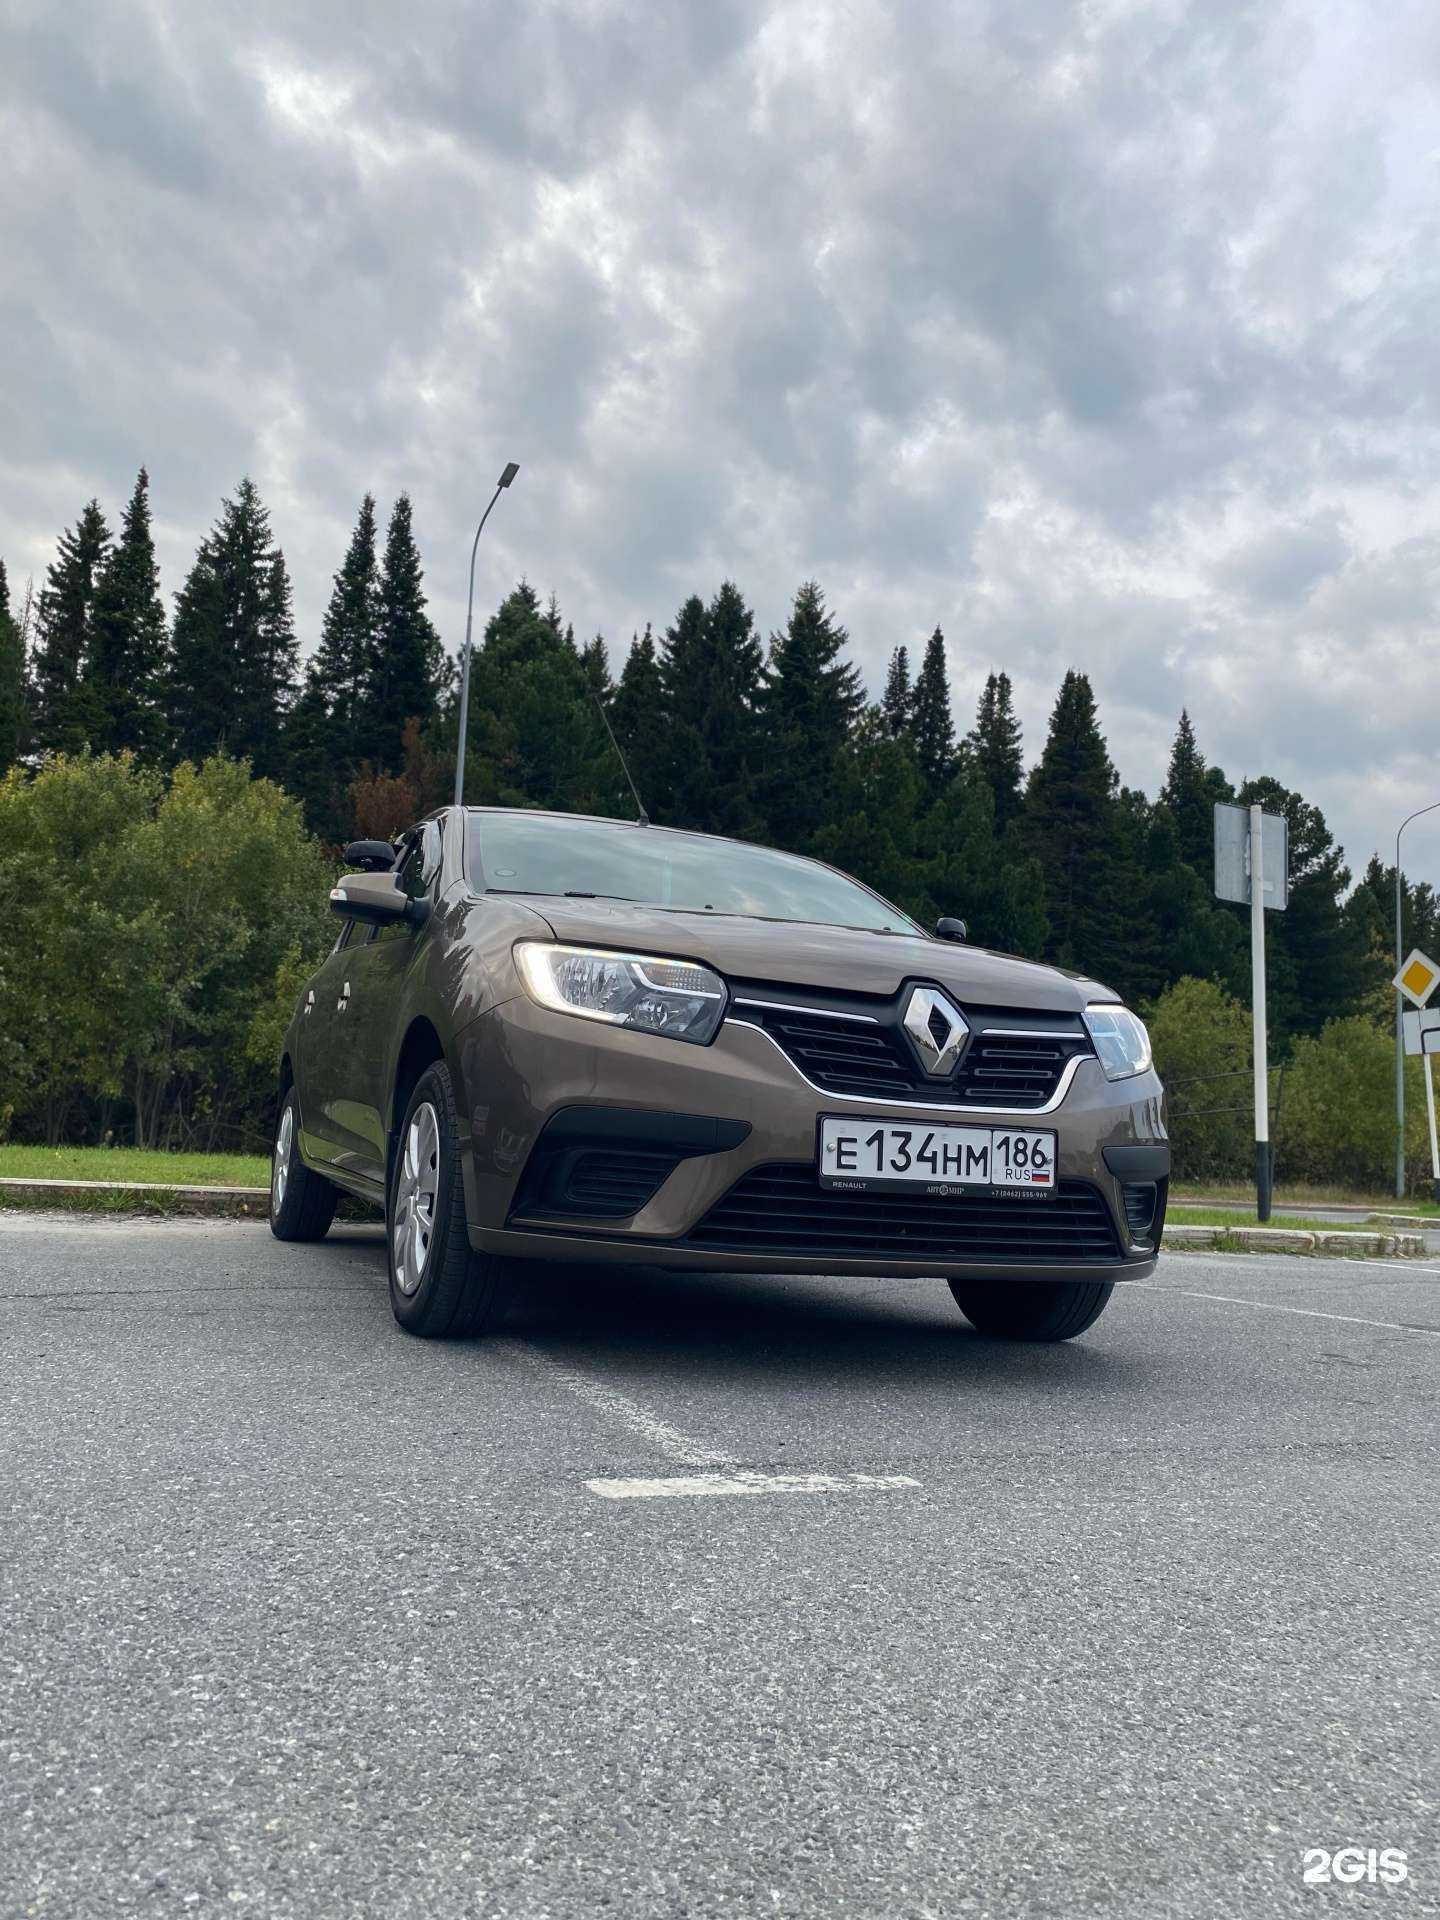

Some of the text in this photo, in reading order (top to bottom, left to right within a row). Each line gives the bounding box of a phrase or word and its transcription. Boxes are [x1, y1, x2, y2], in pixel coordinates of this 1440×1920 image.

[836, 1130, 989, 1177] E134HM
[996, 1136, 1047, 1168] 186
[832, 1181, 867, 1190] RENAULT
[1005, 1168, 1031, 1181] RUS
